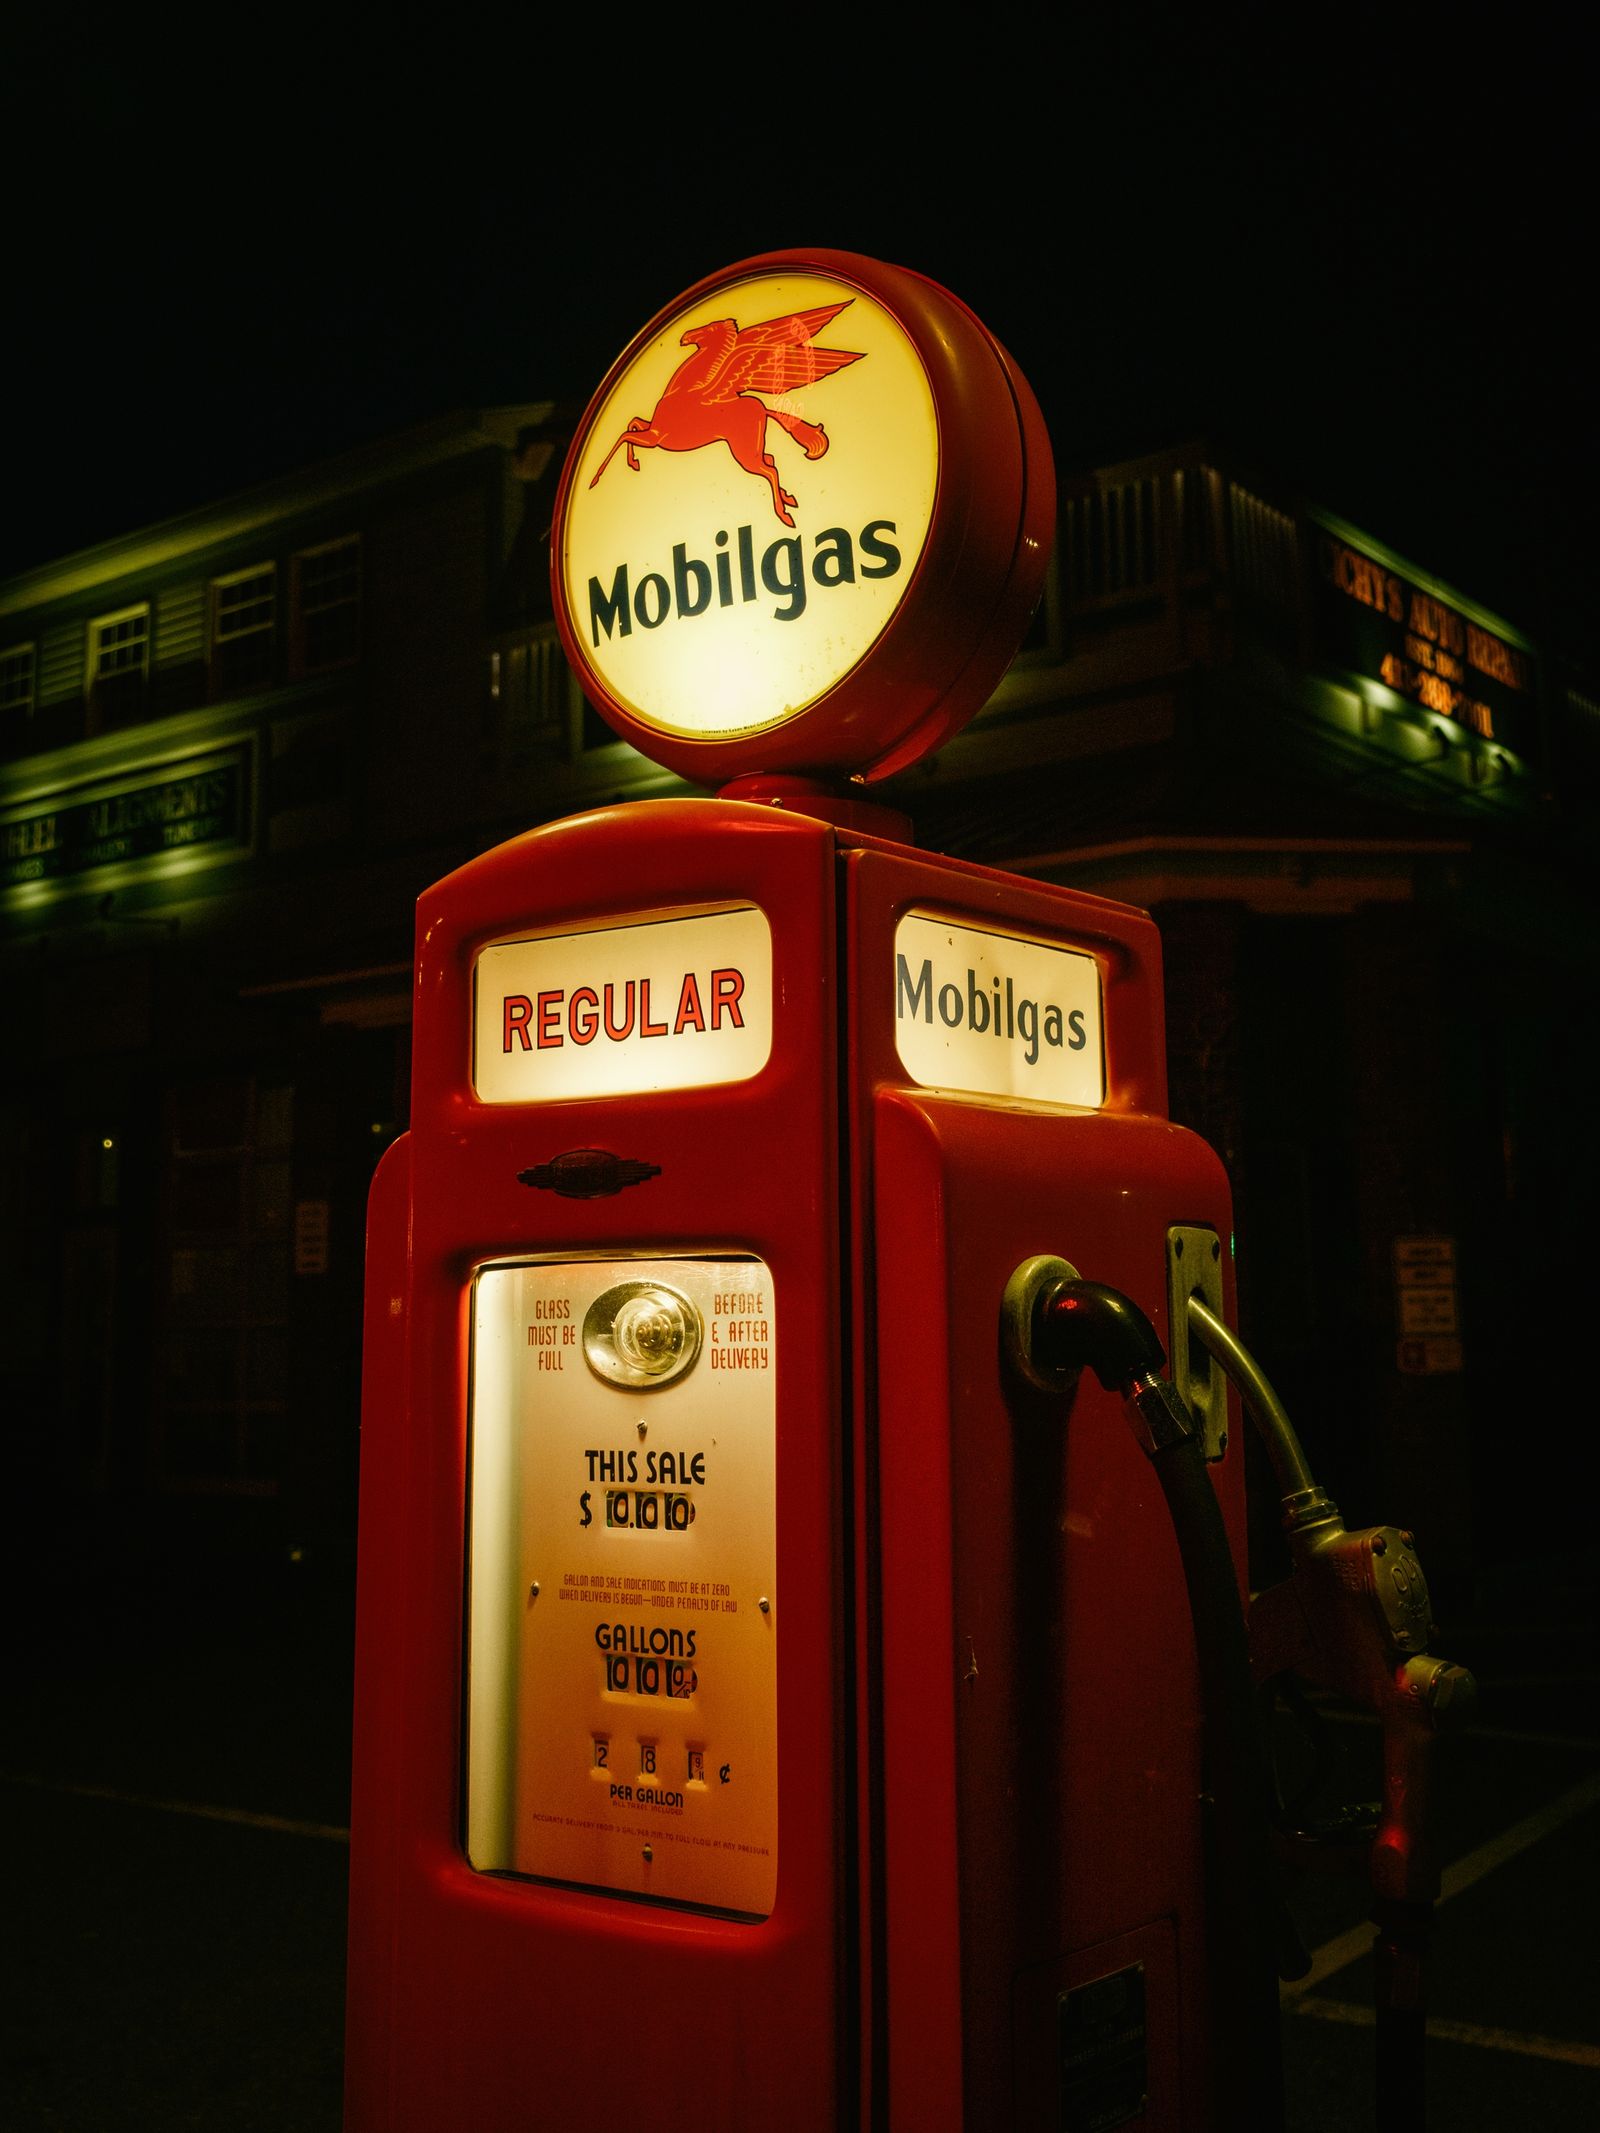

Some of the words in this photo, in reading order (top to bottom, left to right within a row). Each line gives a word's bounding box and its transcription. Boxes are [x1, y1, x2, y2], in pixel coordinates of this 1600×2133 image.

[588, 520, 902, 648] Mobilgas
[503, 967, 745, 1054] REGULAR
[896, 953, 1087, 1066] Mobilgas
[535, 1299, 570, 1320] GLASS
[714, 1292, 764, 1315] BEFORE
[528, 1325, 557, 1346] MUST
[563, 1325, 576, 1345] BE
[729, 1320, 768, 1342] AFTER
[539, 1350, 564, 1371] FULL
[711, 1348, 768, 1370] DELIVERY
[585, 1450, 638, 1483] THIS
[646, 1451, 705, 1485] SALE
[579, 1490, 592, 1528] $
[564, 1574, 588, 1588] GALLON
[590, 1575, 604, 1588] AND
[606, 1576, 622, 1589] SALE
[624, 1578, 666, 1592] INDICATIONS
[669, 1581, 688, 1594] MUST
[690, 1582, 700, 1594] BE
[701, 1583, 710, 1595] AT
[712, 1584, 730, 1597] ZERO
[559, 1588, 579, 1600] WHEN
[580, 1590, 611, 1604] DELIVERY
[613, 1592, 620, 1604] IS
[677, 1597, 709, 1611] PENALTY
[711, 1600, 719, 1612] OF
[721, 1601, 738, 1613] LAW
[595, 1623, 696, 1658] GALLONS
[597, 1746, 608, 1768] 2
[645, 1750, 656, 1774] 8
[610, 1783, 632, 1800] PER
[636, 1788, 683, 1808] GALLON
[612, 1800, 626, 1809] ALL
[651, 1805, 683, 1816] INCLUDED
[533, 1813, 563, 1825] ACCURATE
[565, 1818, 594, 1829] DELIVERY
[596, 1823, 614, 1832] FROM
[637, 1829, 649, 1837] PER
[665, 1832, 673, 1841] TO
[675, 1834, 690, 1844] FULL
[692, 1837, 711, 1846] FLOW
[713, 1840, 721, 1849] AT
[722, 1841, 736, 1850] ANY
[738, 1844, 769, 1857] PRESSURE
